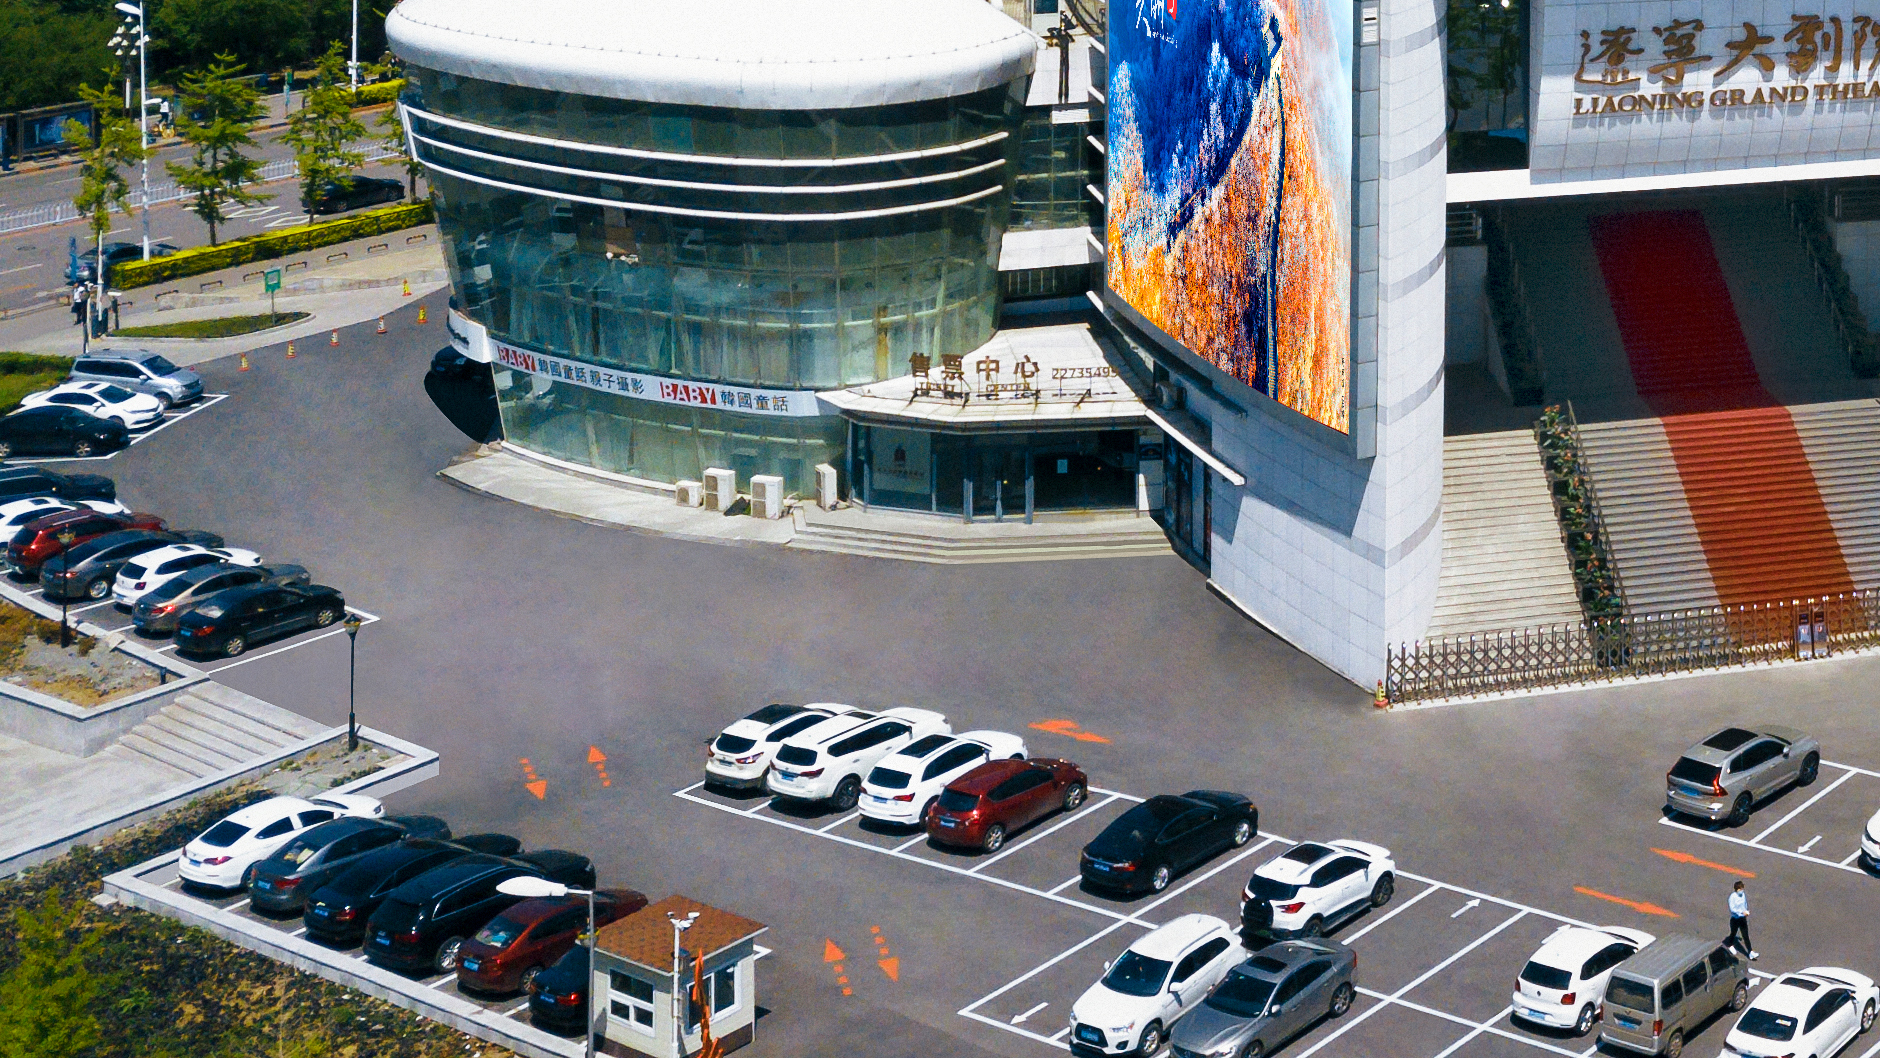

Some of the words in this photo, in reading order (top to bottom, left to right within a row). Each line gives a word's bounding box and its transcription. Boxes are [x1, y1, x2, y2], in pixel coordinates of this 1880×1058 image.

[1573, 91, 1704, 115] LIAONING
[1709, 84, 1808, 106] GRAND
[497, 346, 537, 372] BABY
[909, 352, 1040, 381] 售票中心
[660, 382, 717, 406] BABY
